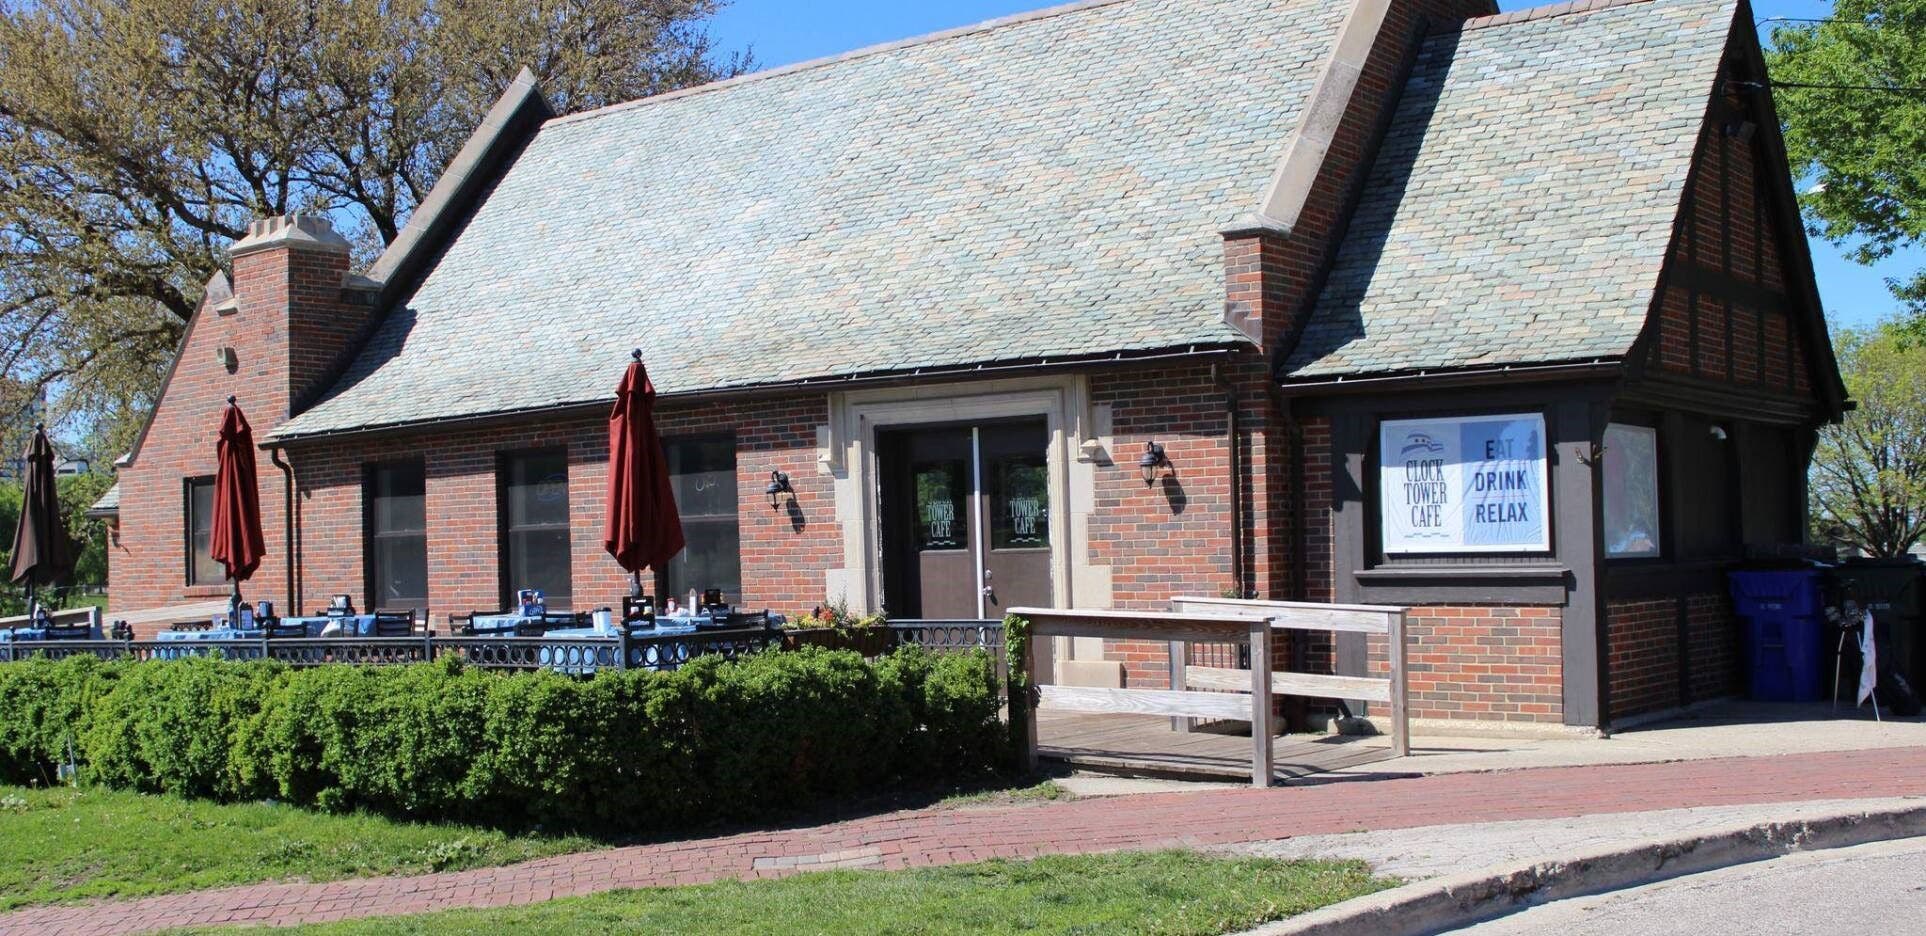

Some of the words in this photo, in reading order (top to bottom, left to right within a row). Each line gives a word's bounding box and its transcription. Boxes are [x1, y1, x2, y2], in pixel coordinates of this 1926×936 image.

[1485, 439, 1515, 460] EAT
[1405, 458, 1445, 482] CLOCK
[1475, 470, 1528, 492] DRINK
[1403, 481, 1448, 505] TOWER
[926, 503, 955, 521] TOWER
[1009, 499, 1040, 518] TOWER
[1411, 504, 1442, 527] CAFE
[1475, 502, 1529, 523] RELAX
[931, 520, 951, 538] CAFE
[1014, 517, 1036, 535] CAFE
